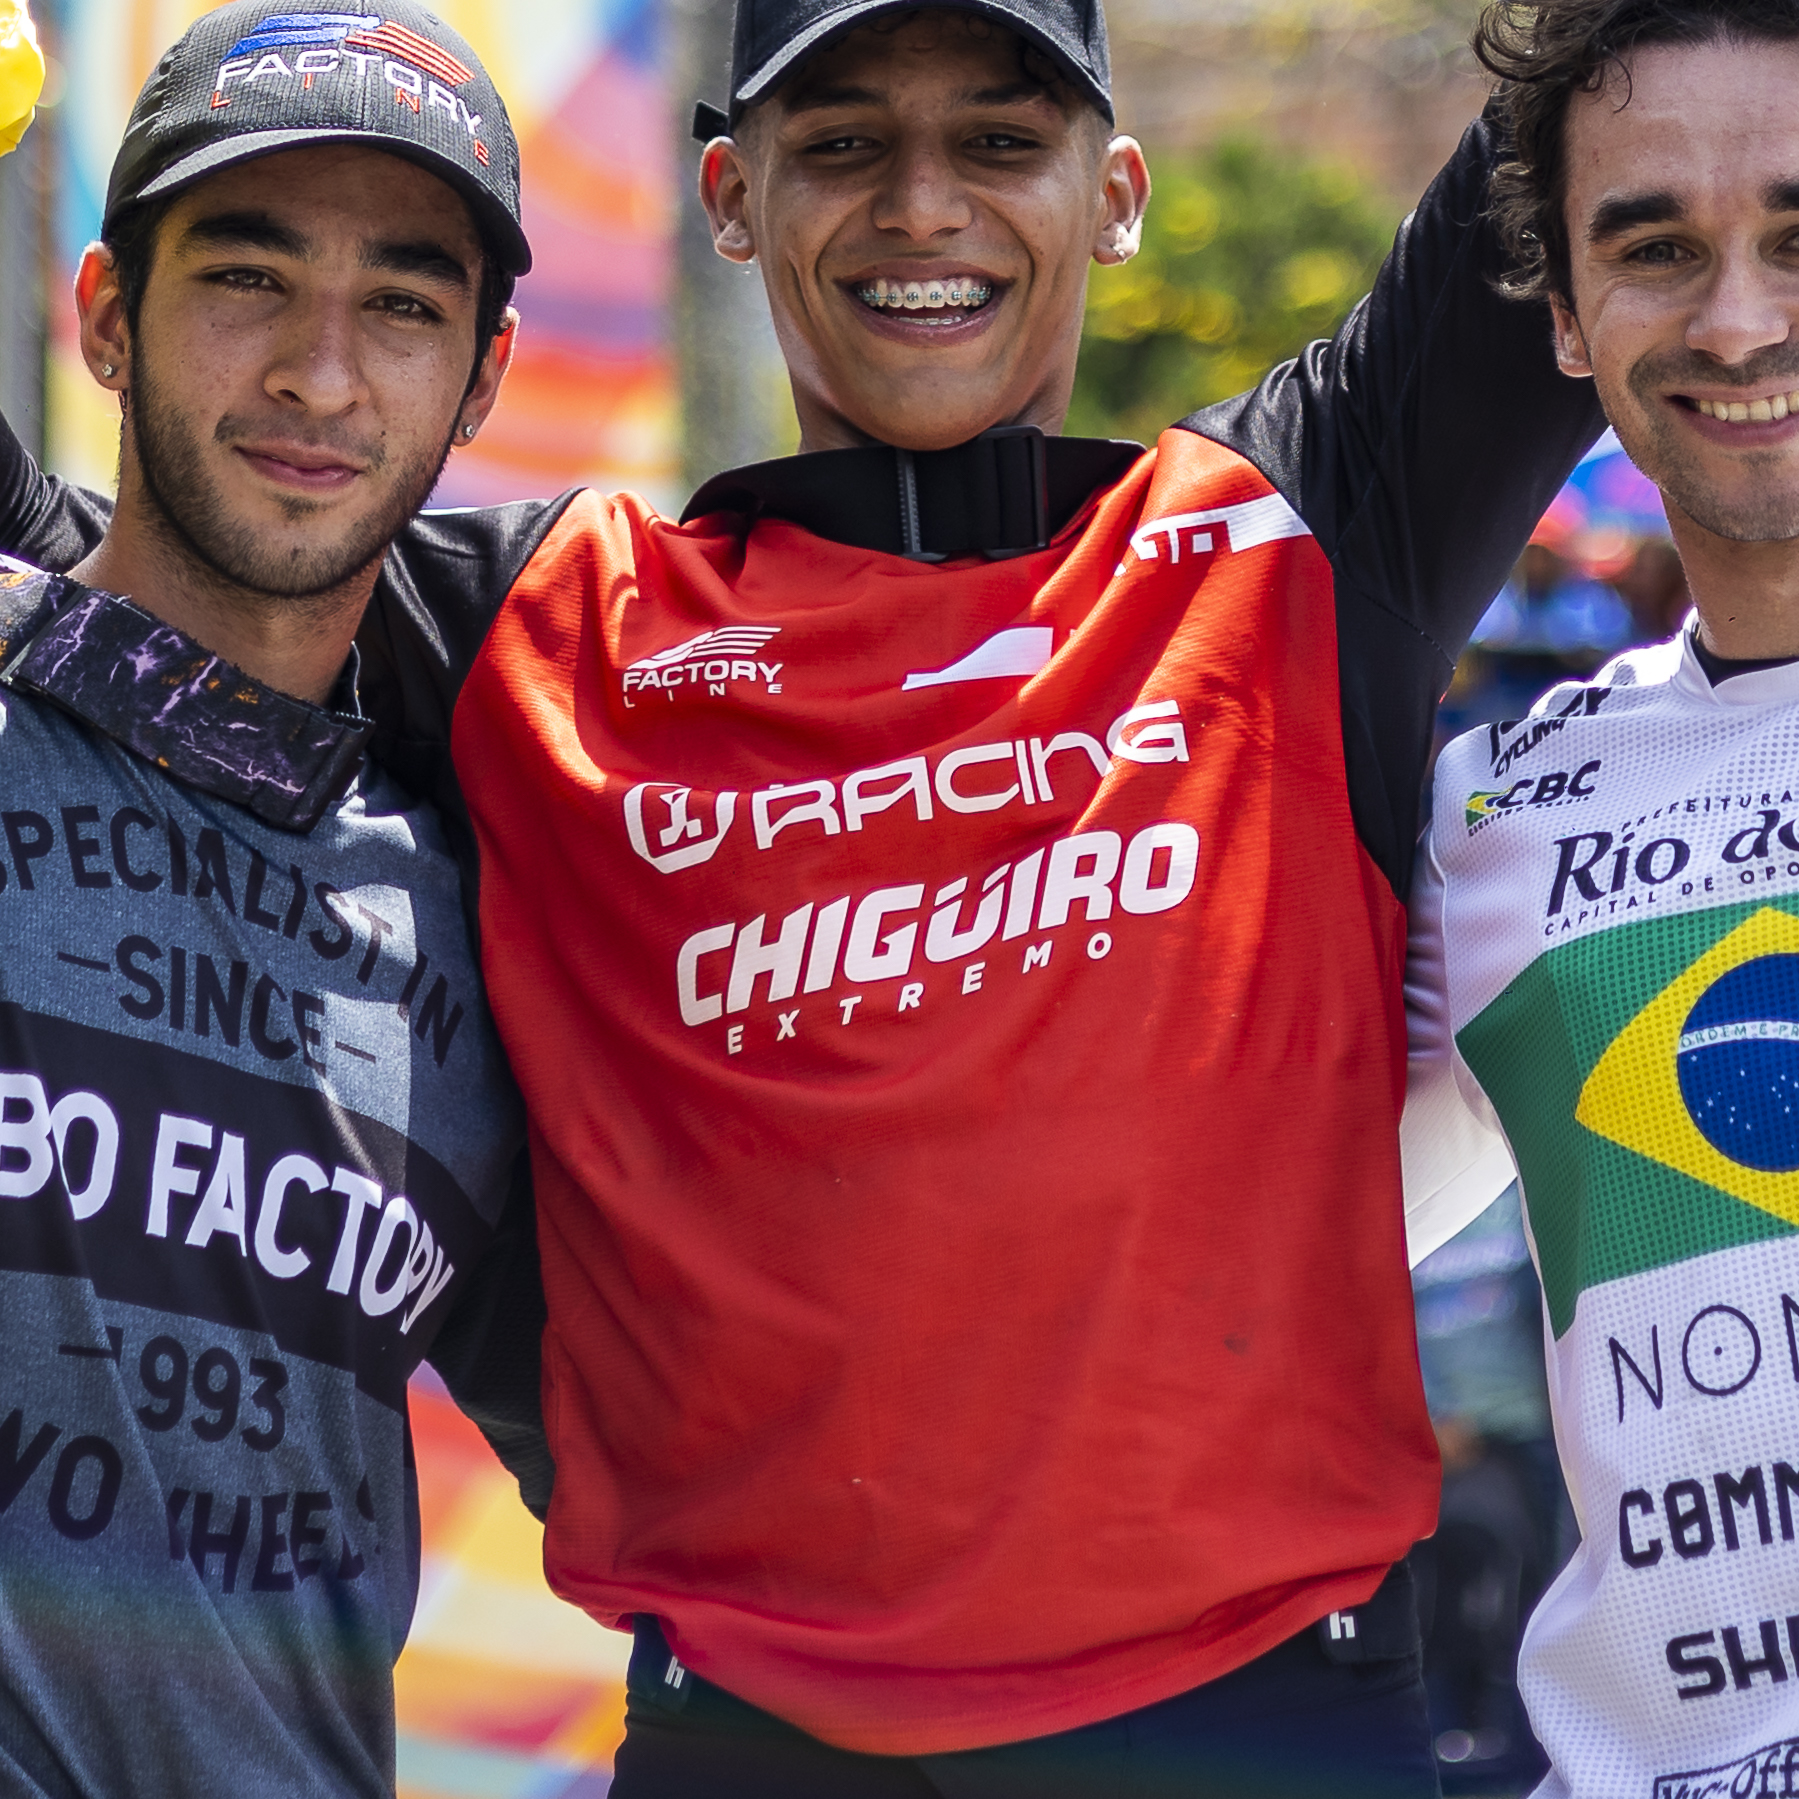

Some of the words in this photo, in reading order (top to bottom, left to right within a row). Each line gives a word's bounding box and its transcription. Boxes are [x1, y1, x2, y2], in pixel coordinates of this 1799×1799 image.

[210, 72, 489, 166] LINE
[214, 48, 482, 135] FACTORY
[621, 659, 784, 693] FACTORY
[623, 681, 783, 709] LINE
[1496, 759, 1602, 809] CBC
[1620, 790, 1793, 833] PREFEITURA
[1544, 891, 1657, 937] CAPITAL
[1681, 877, 1714, 896] DE
[1546, 830, 1690, 918] Rio
[397, 949, 465, 1068] IN
[726, 932, 1113, 1056] EXTREMO
[1680, 1026, 1747, 1049] ORDEM
[1758, 1023, 1768, 1036] E
[145, 1112, 455, 1335] FACTORY
[164, 1473, 383, 1595] HEE
